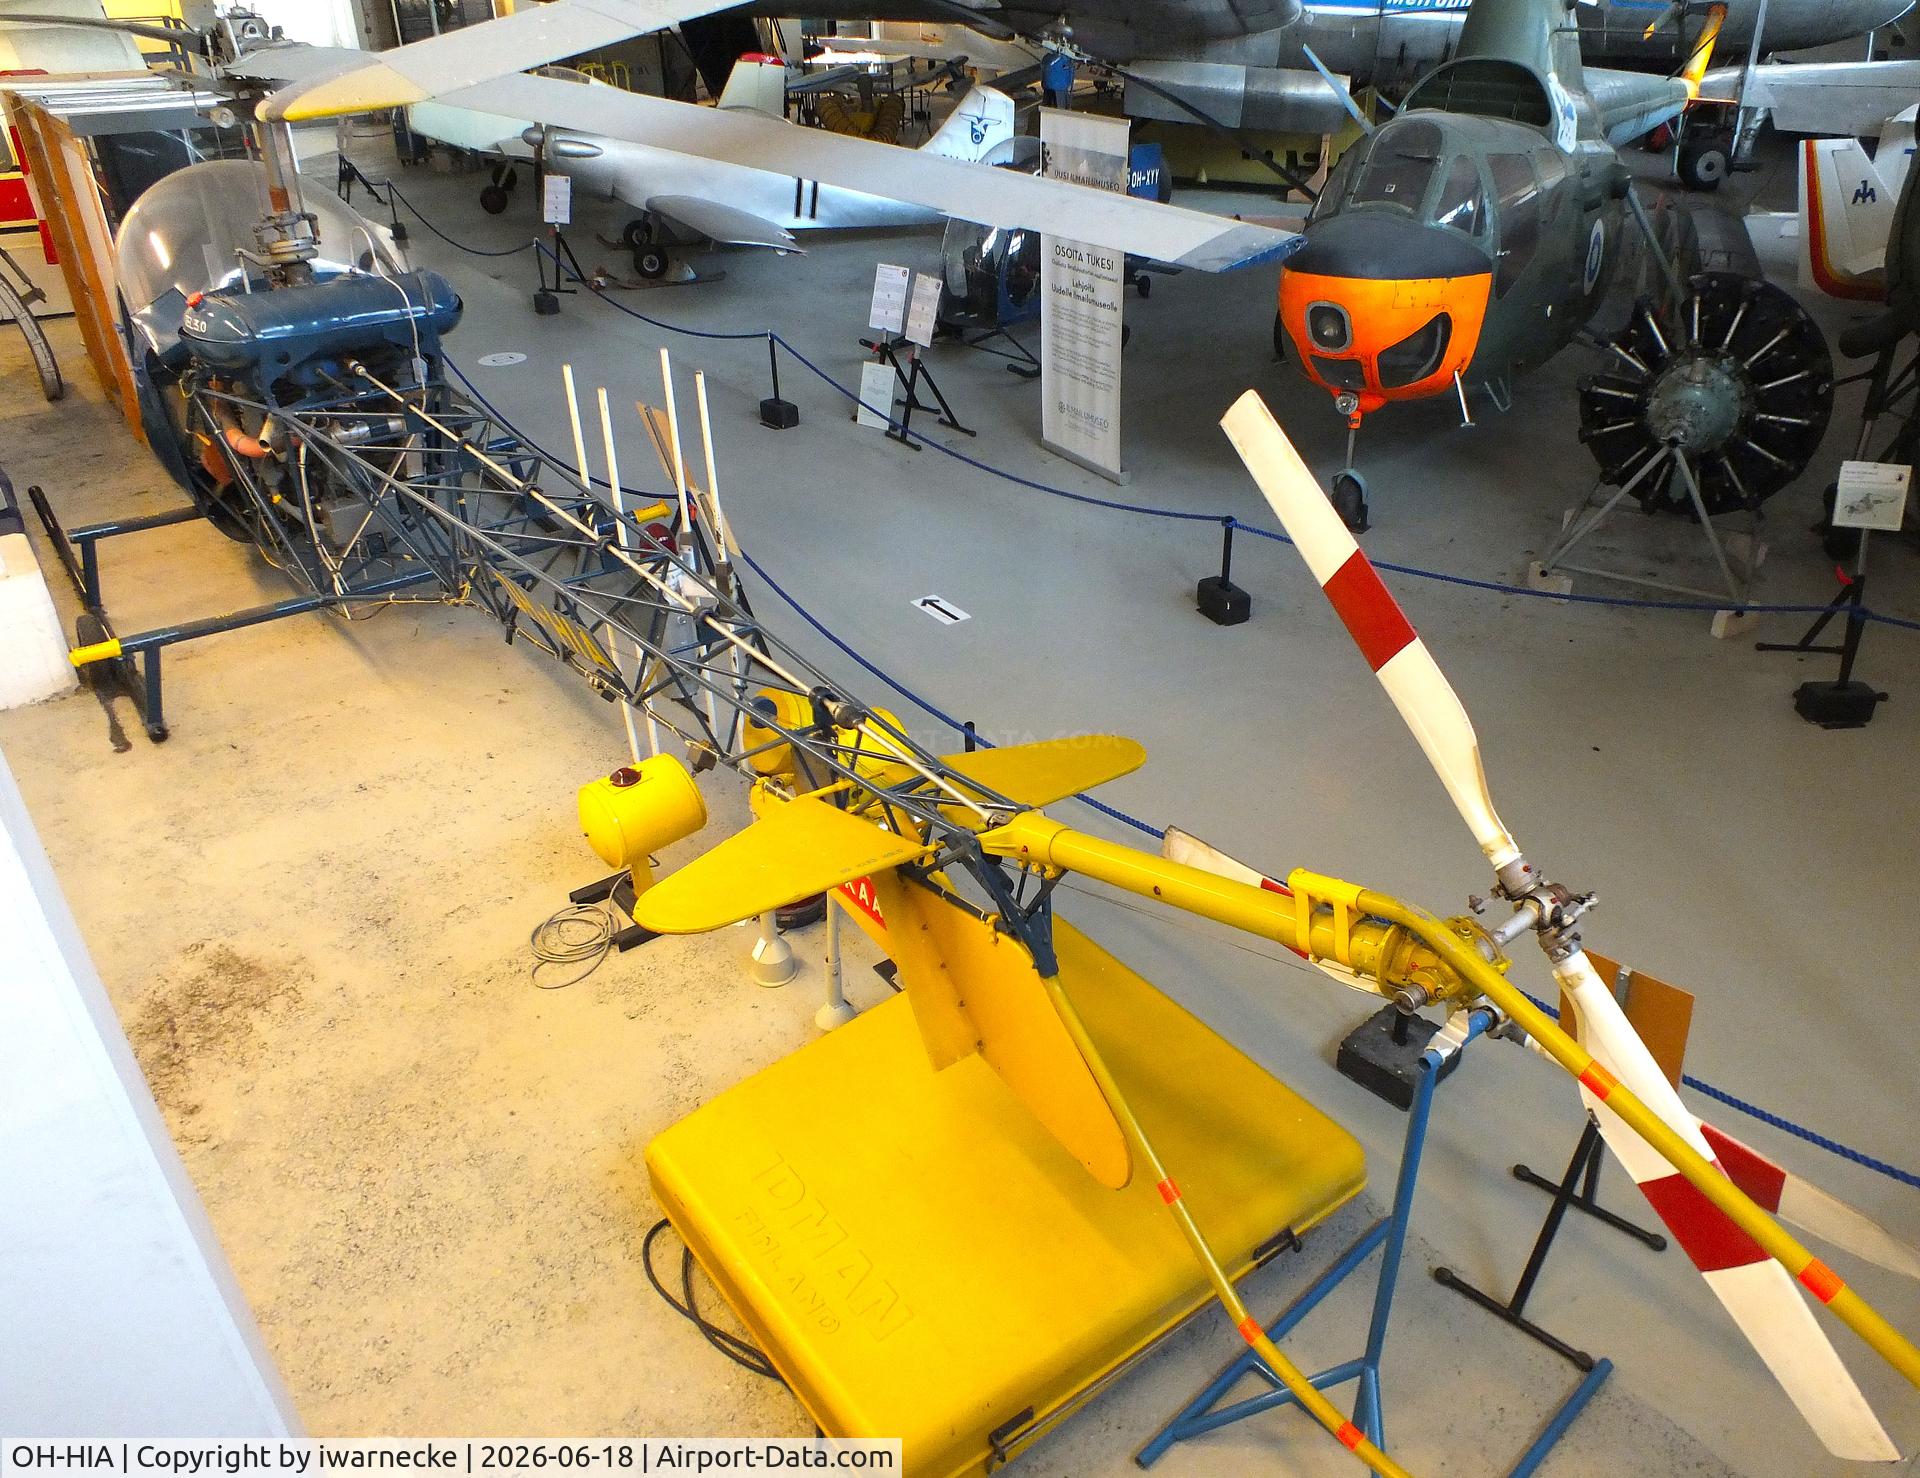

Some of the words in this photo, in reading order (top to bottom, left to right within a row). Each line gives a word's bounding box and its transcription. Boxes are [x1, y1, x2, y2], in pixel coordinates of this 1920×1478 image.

[1054, 169, 1069, 181] UUSI
[1131, 168, 1160, 189] OH-XYY
[1055, 244, 1084, 263] OSOITA
[1086, 252, 1115, 271] TUKESI
